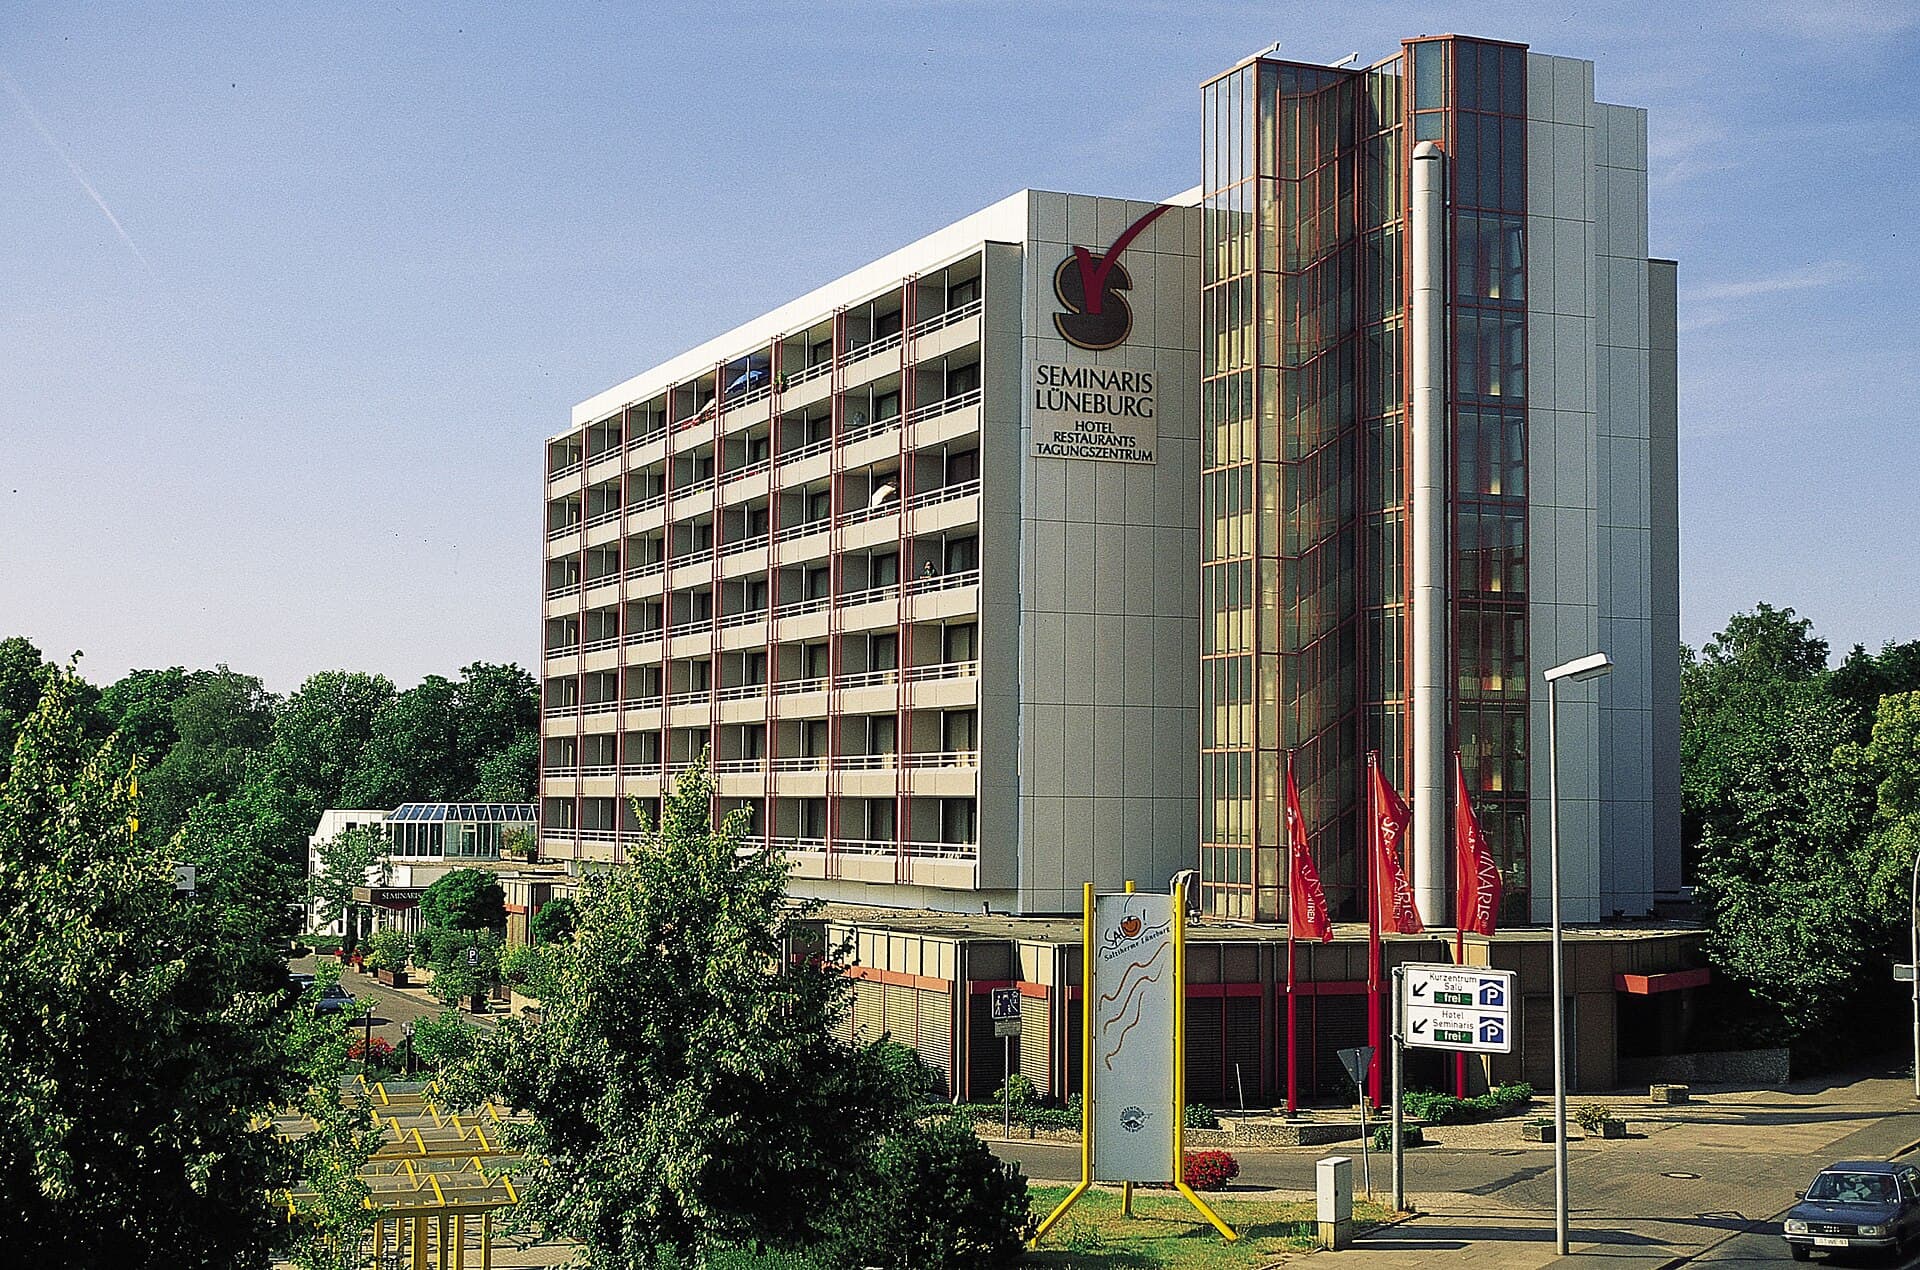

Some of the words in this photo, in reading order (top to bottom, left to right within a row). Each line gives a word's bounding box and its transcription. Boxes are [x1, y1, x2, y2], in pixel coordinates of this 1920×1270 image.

[1036, 365, 1153, 393] SEMINARIS
[1036, 387, 1153, 418] LÜNEBURG
[1075, 421, 1115, 434] HOTEL
[1053, 431, 1136, 448] RESTAURANTS
[1036, 443, 1153, 461] TAGUNGSZENTRUM
[1430, 972, 1477, 983] Kurzentrum
[1444, 992, 1461, 1003] frei
[1486, 988, 1499, 1005] P
[1441, 1010, 1464, 1019] Hotel
[1433, 1019, 1474, 1030] Seminaris
[1444, 1030, 1461, 1041] frei
[1486, 1026, 1499, 1042] P
